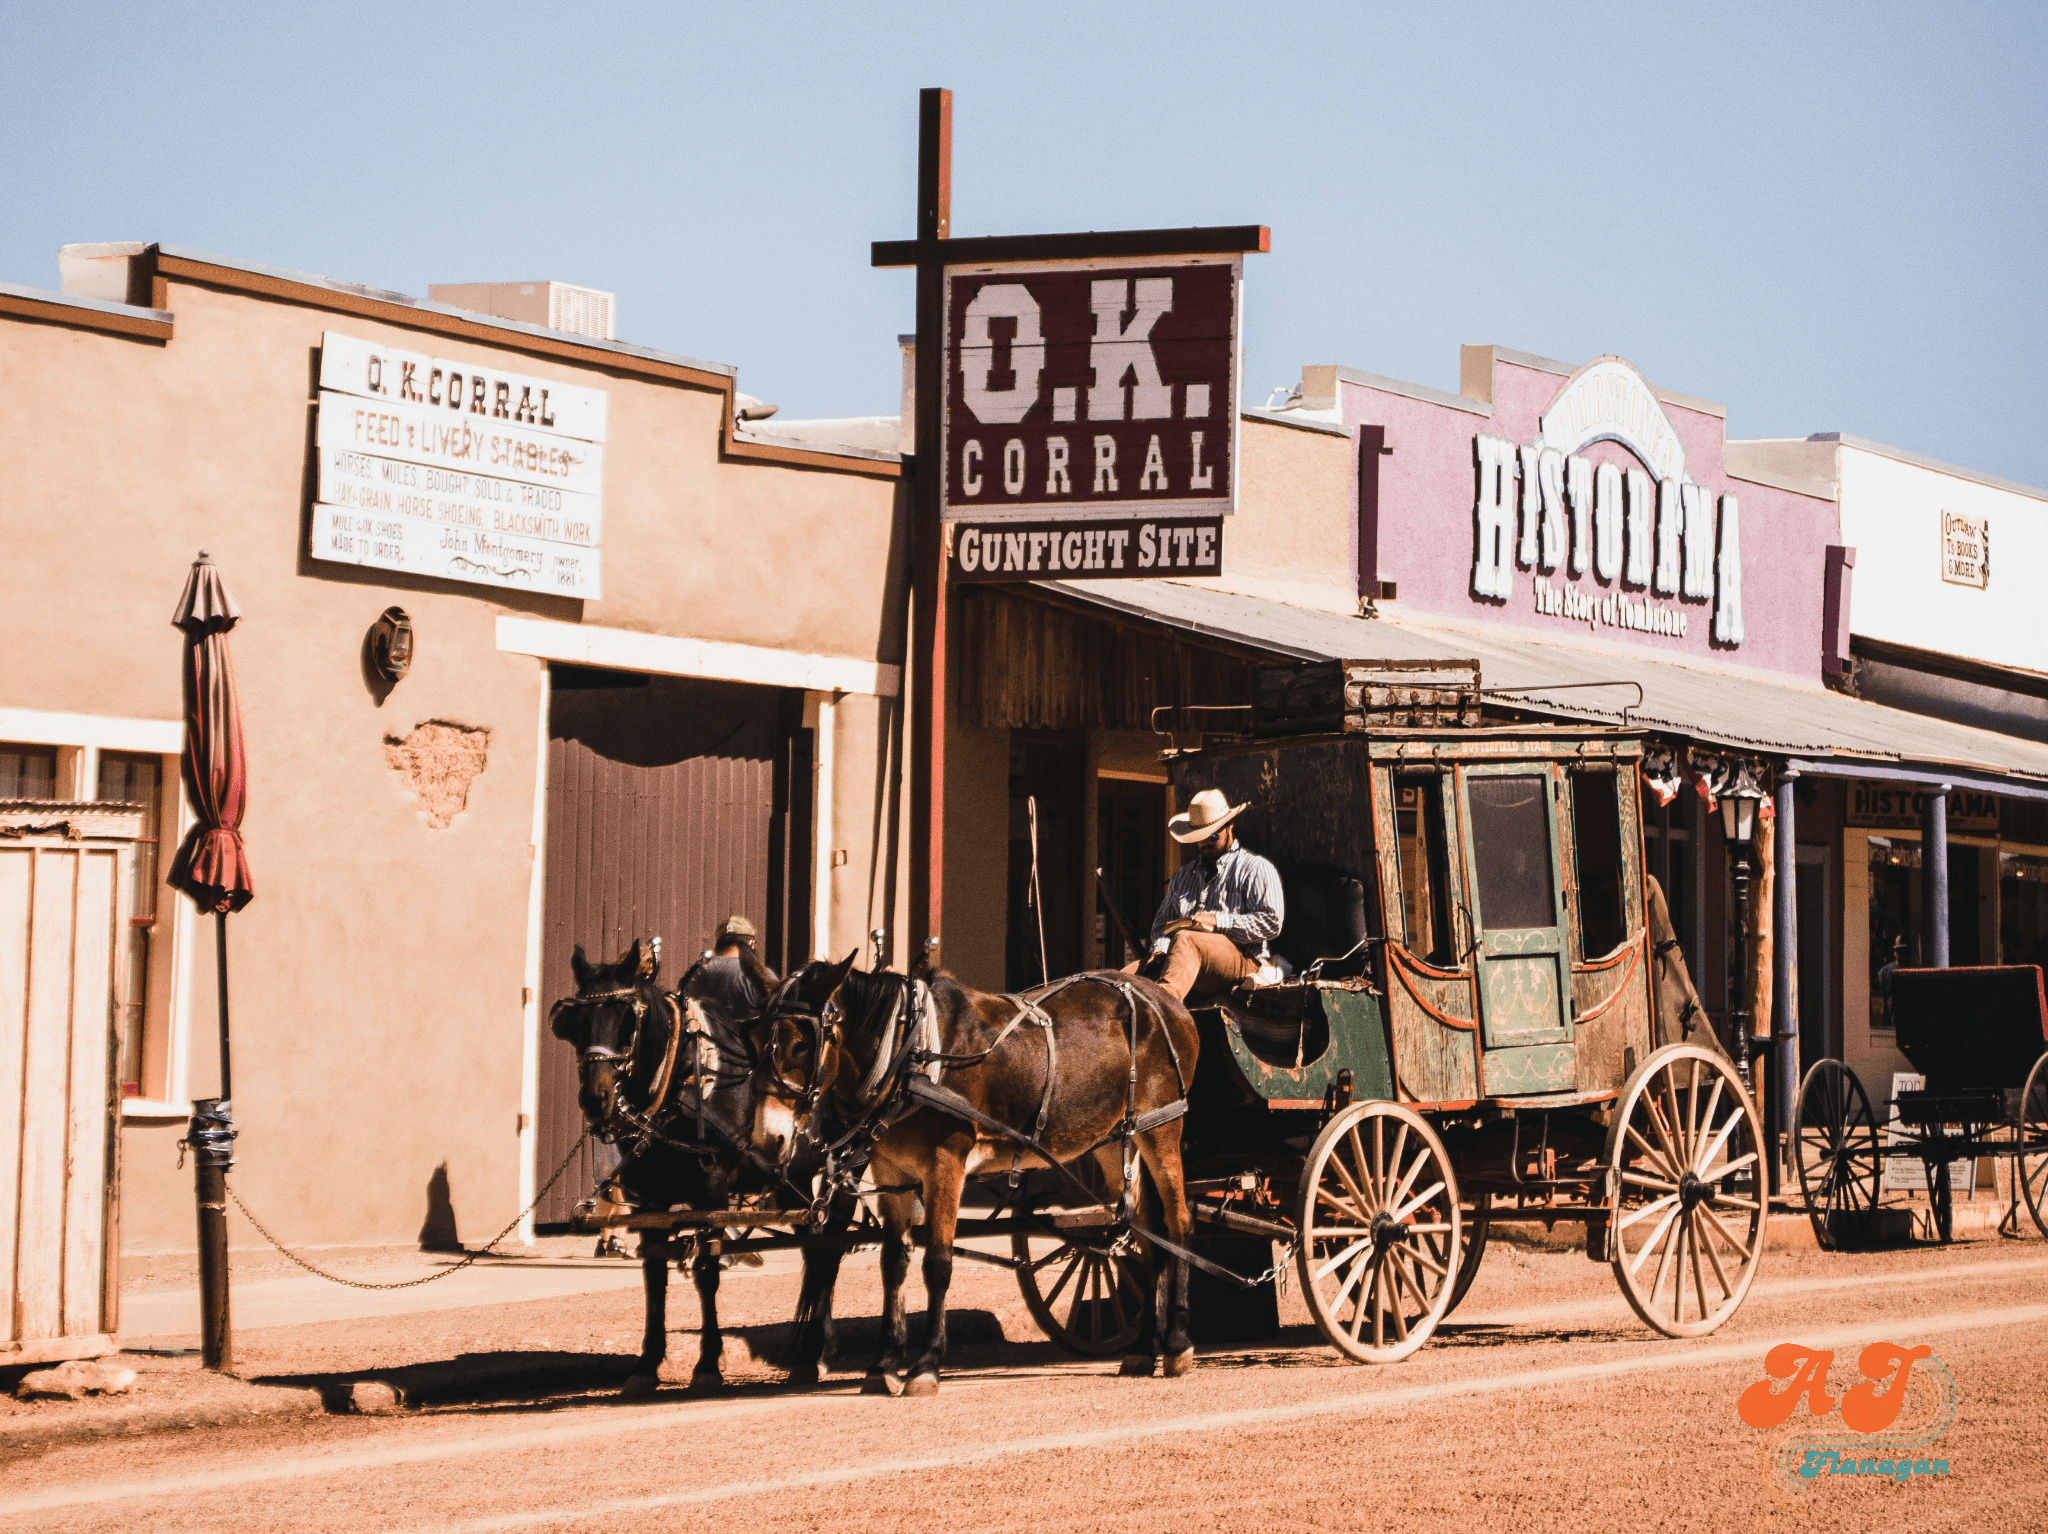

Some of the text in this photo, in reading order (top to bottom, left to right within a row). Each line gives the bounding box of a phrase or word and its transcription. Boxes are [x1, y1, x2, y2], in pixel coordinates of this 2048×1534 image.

[959, 277, 1211, 424] O.K.
[353, 410, 400, 447] FEED
[421, 419, 483, 464] LIVERY
[491, 436, 571, 478] STABLES
[962, 432, 1213, 496] CORRAL
[334, 482, 353, 503] HAY
[397, 493, 432, 519] HORSE
[494, 513, 559, 538] BLACKSMITH
[563, 519, 591, 542] WORK
[519, 485, 562, 511] TRADED
[331, 534, 353, 553] MADE
[359, 541, 369, 555] TO
[332, 515, 353, 531] MULE
[363, 522, 372, 536] OX
[376, 522, 403, 540] SHOES
[440, 528, 543, 573] John Montgomery
[959, 524, 1216, 572] GUNFIGHT SITE
[1472, 434, 1745, 647] HISTORAMA
[557, 570, 575, 587] 1881
[1955, 560, 1974, 578] MORE
[1534, 577, 1687, 636] The Story of Tombstone
[1856, 790, 1997, 818] HISTOAMA
